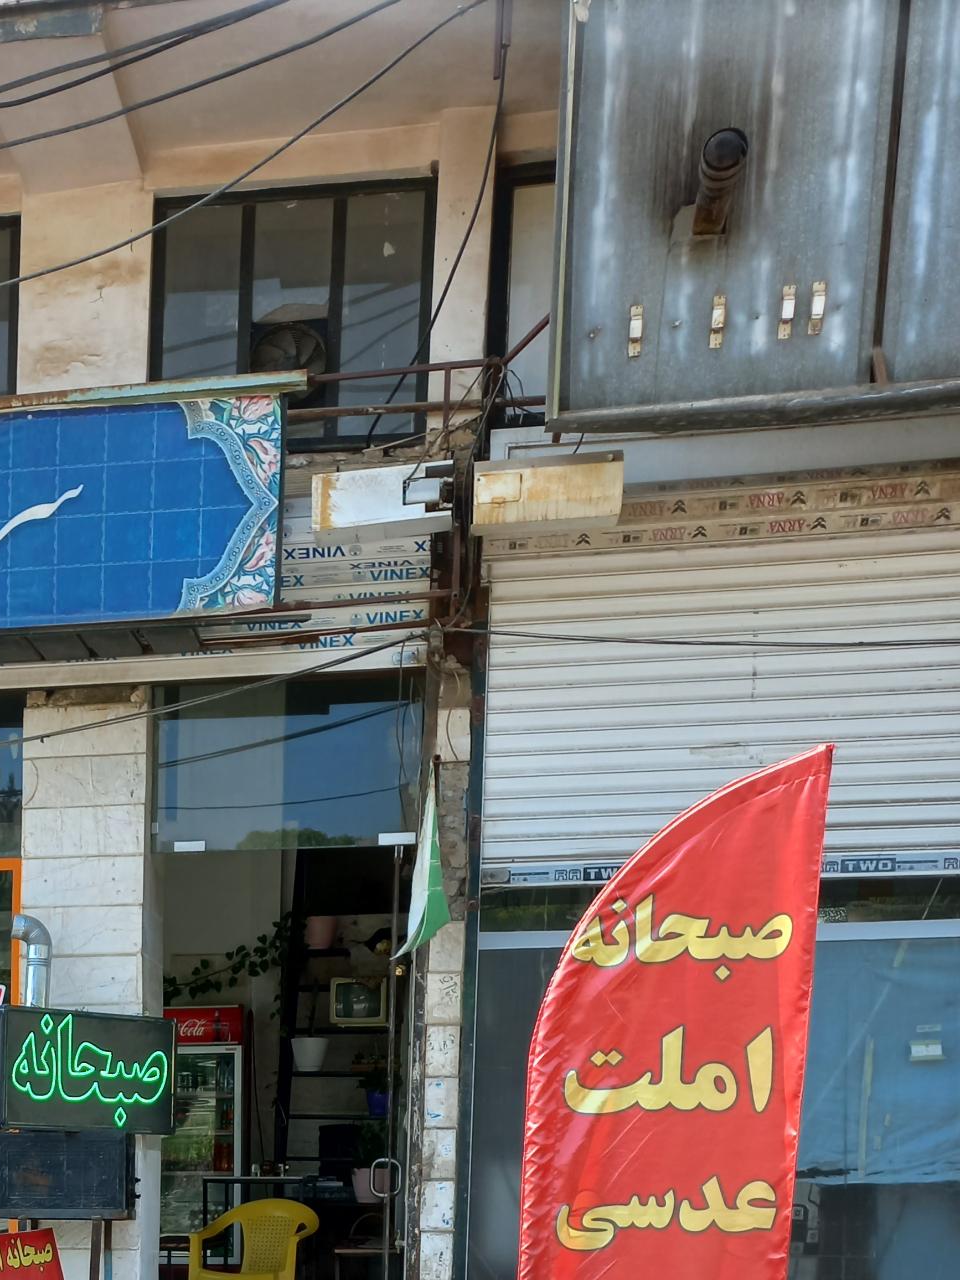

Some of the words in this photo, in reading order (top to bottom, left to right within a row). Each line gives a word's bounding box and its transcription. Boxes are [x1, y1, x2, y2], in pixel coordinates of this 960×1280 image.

[284, 545, 346, 560] VINEX
[370, 566, 431, 581] VINEX
[366, 609, 425, 625] VINEX
[820, 861, 839, 873] A
[845, 860, 892, 872] TWO
[944, 857, 960, 870] R
[586, 867, 619, 880] TW
[569, 892, 795, 981] صبحانه
[11, 1013, 168, 1127] صبحانه
[564, 1025, 774, 1113] املت
[555, 1175, 778, 1251] عدسی
[6, 1237, 53, 1272] صبحانه
